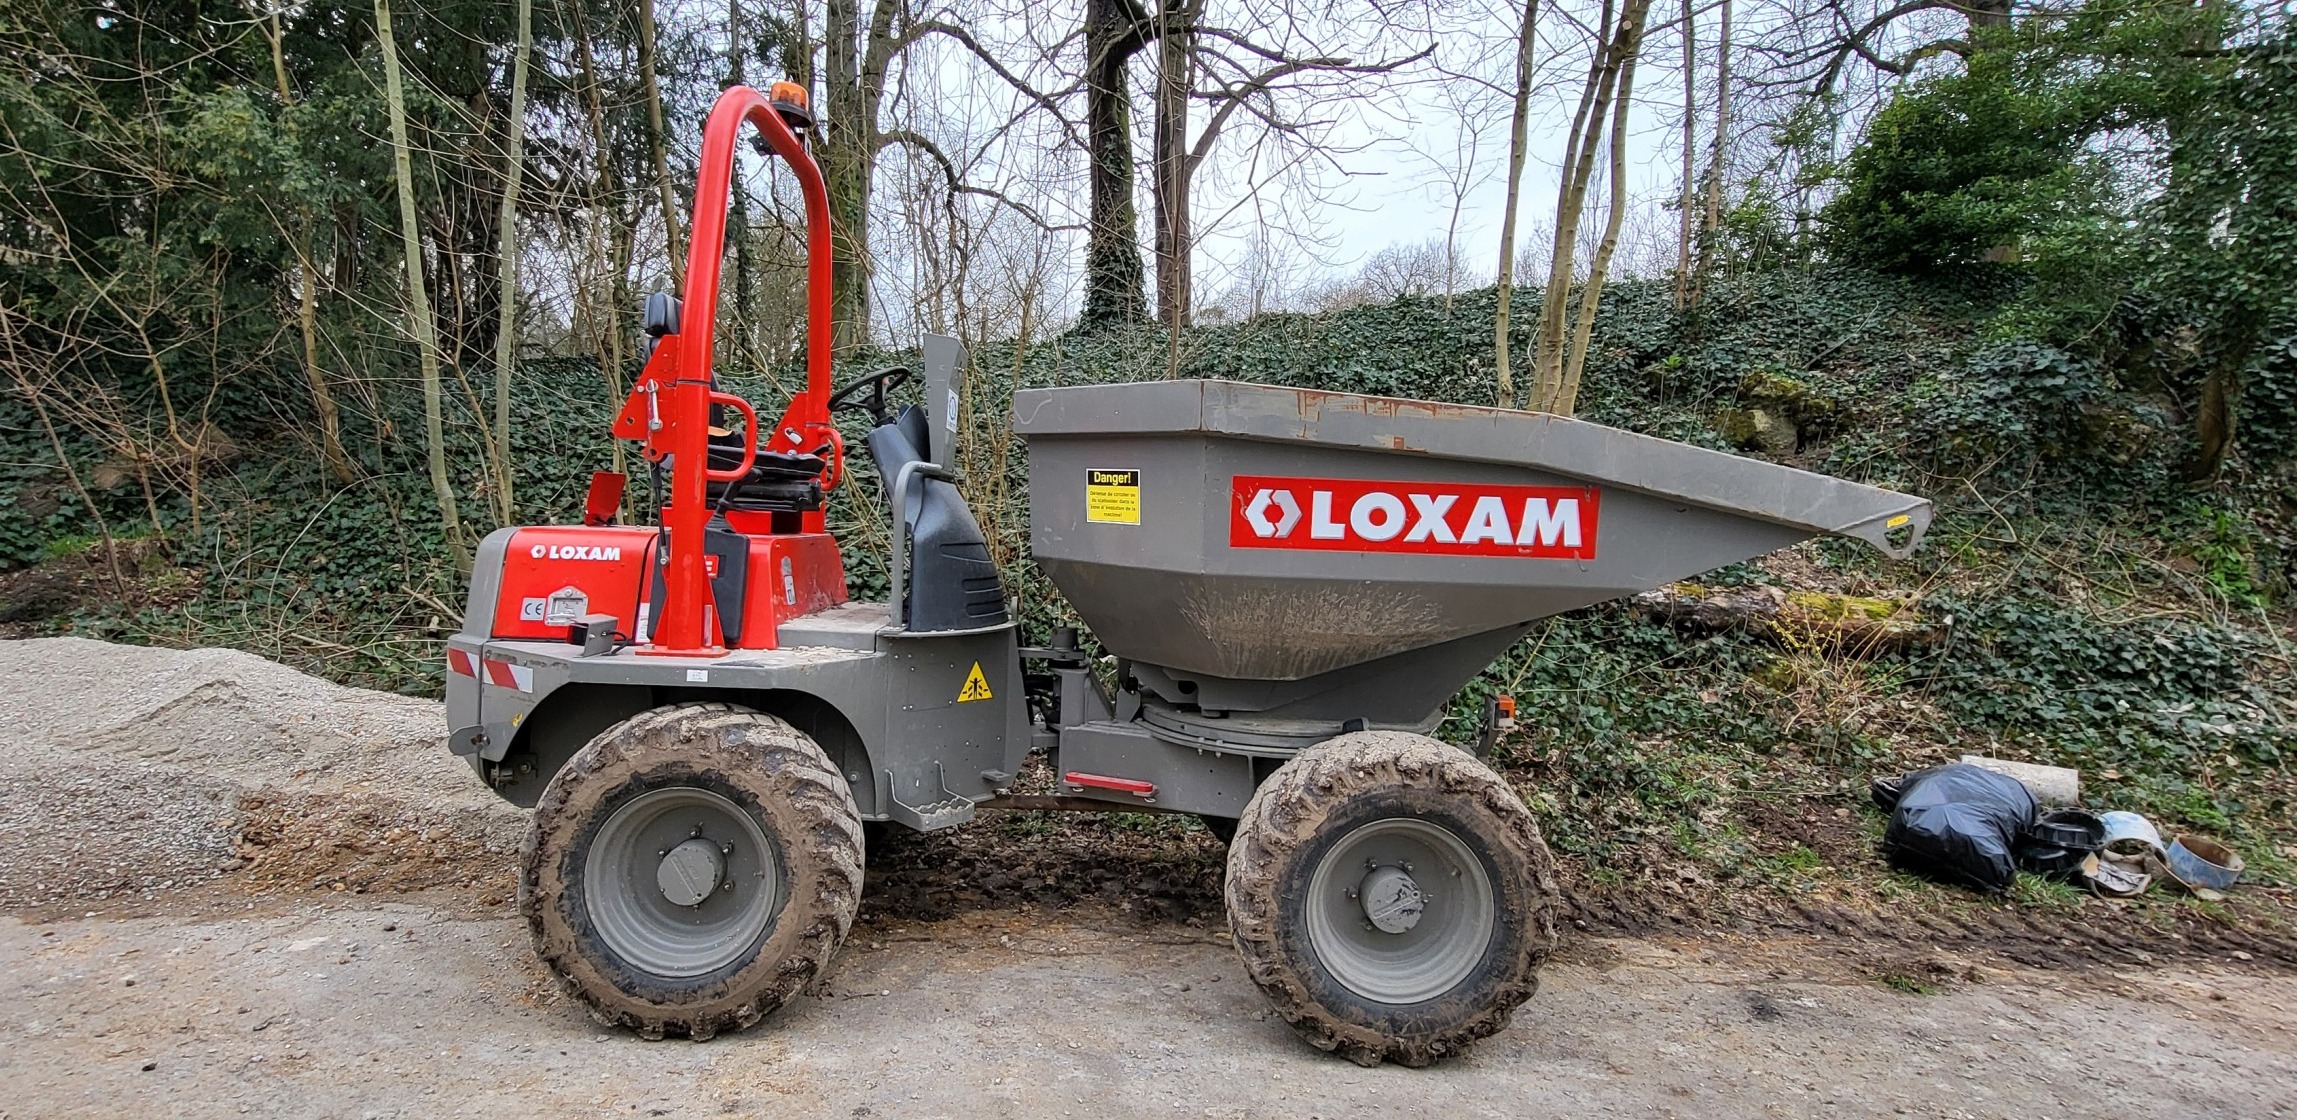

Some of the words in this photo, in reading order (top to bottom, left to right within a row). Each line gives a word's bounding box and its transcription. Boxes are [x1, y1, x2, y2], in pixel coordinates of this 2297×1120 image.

[1094, 471, 1131, 486] Danger!
[1310, 490, 1582, 547] LOXAM
[549, 545, 621, 561] LOXAM
[525, 602, 543, 616] CE
